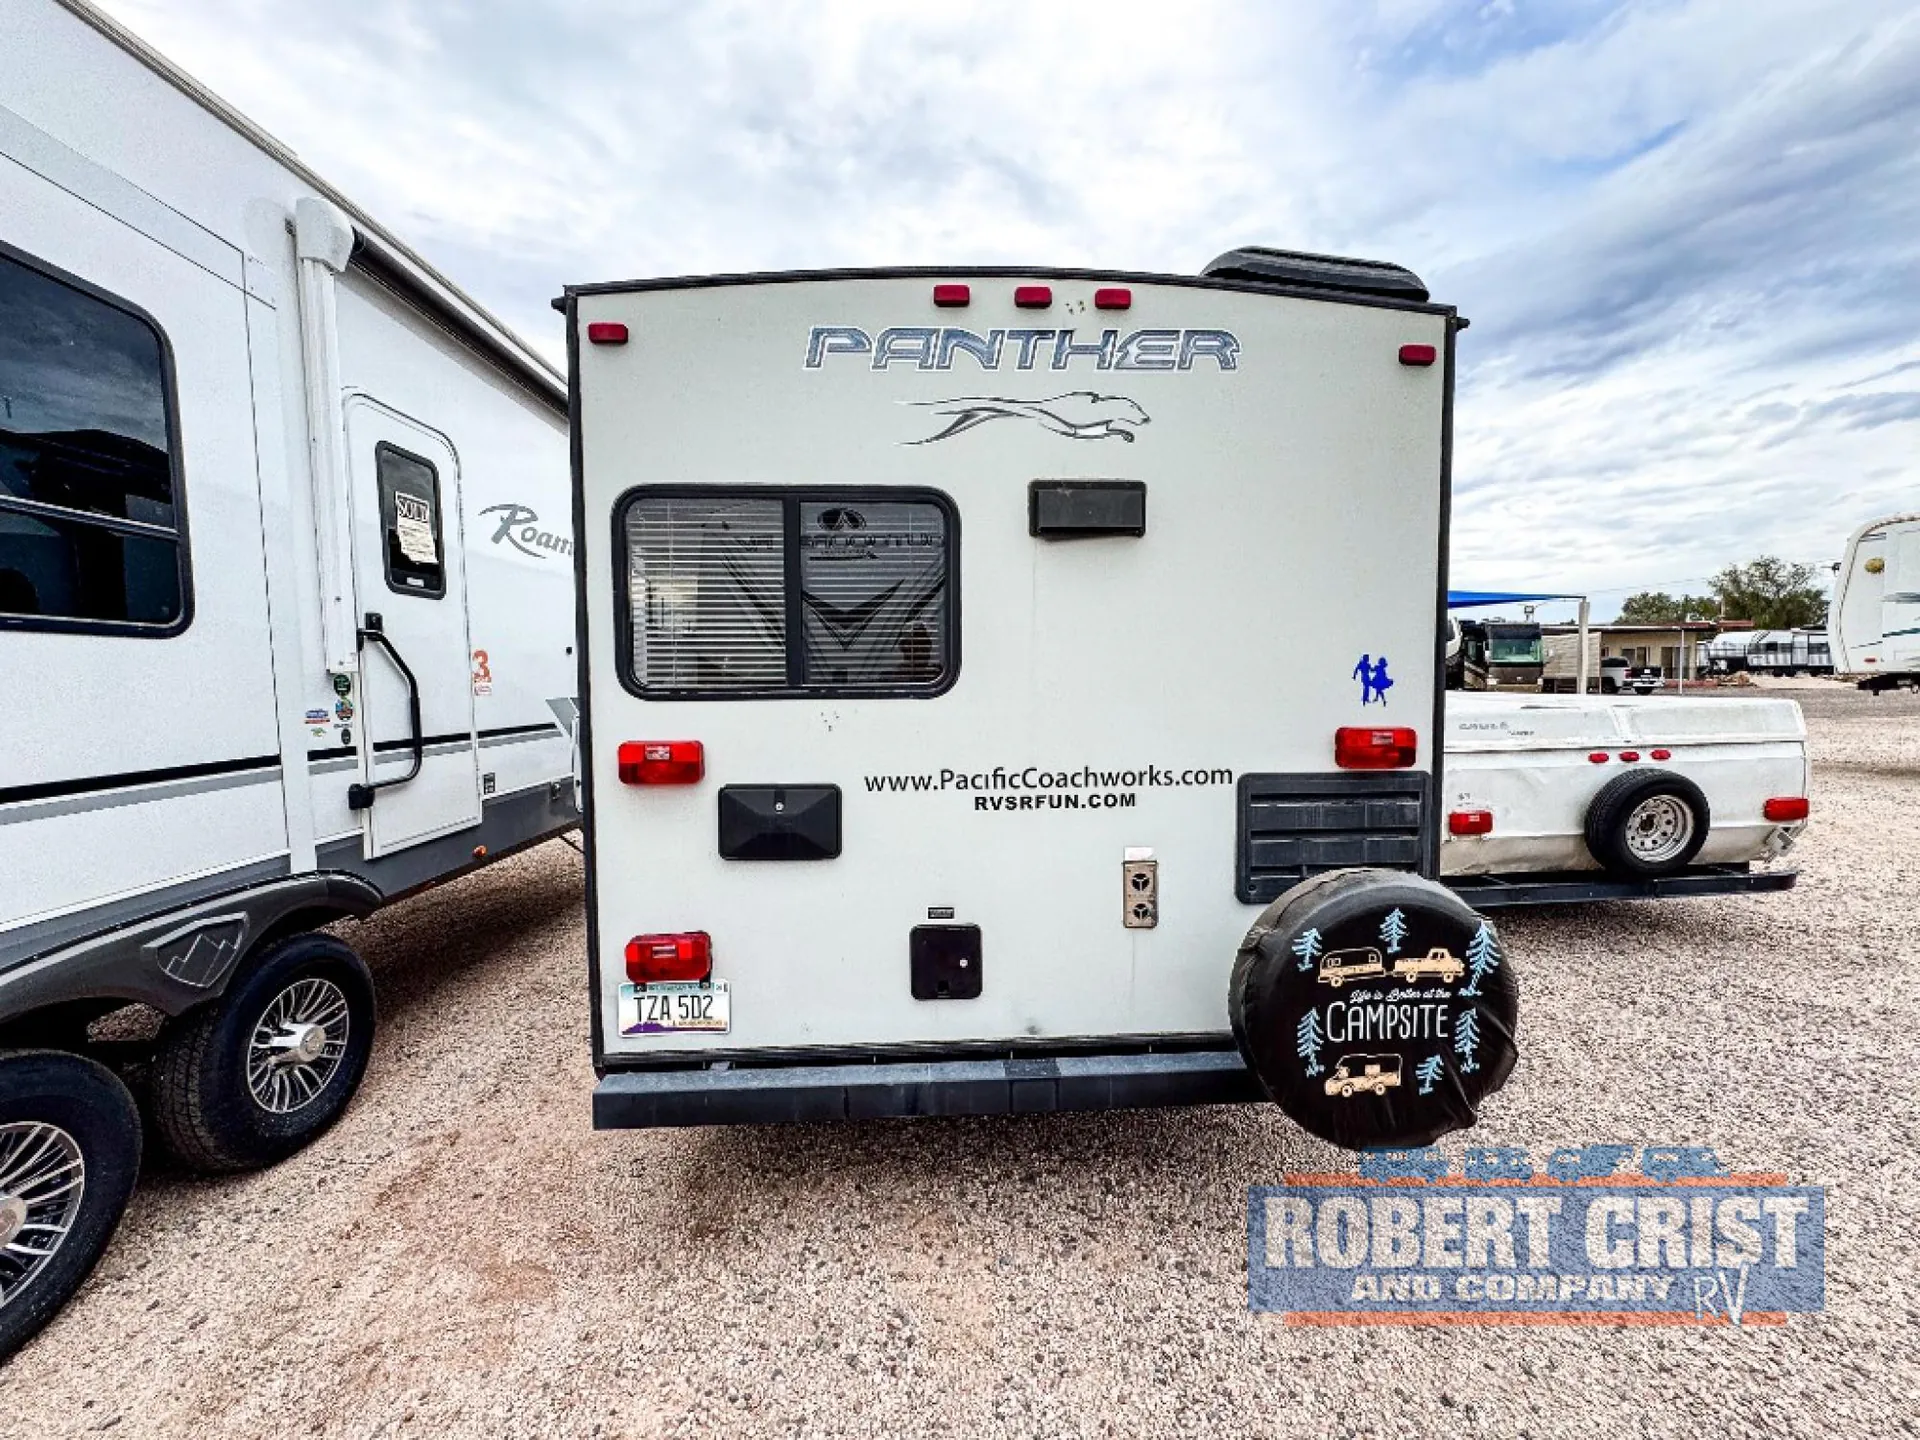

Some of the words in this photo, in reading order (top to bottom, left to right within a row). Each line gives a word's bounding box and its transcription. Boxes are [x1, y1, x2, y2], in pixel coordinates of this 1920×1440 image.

[803, 326, 1241, 371] PANTHER
[864, 765, 1233, 792] www.PacificCoachworks.com
[974, 793, 1136, 811] RVSRFUN.COM
[633, 995, 672, 1022] TZA
[678, 994, 713, 1020] 5D2
[1327, 1001, 1449, 1043] CAMPSITE
